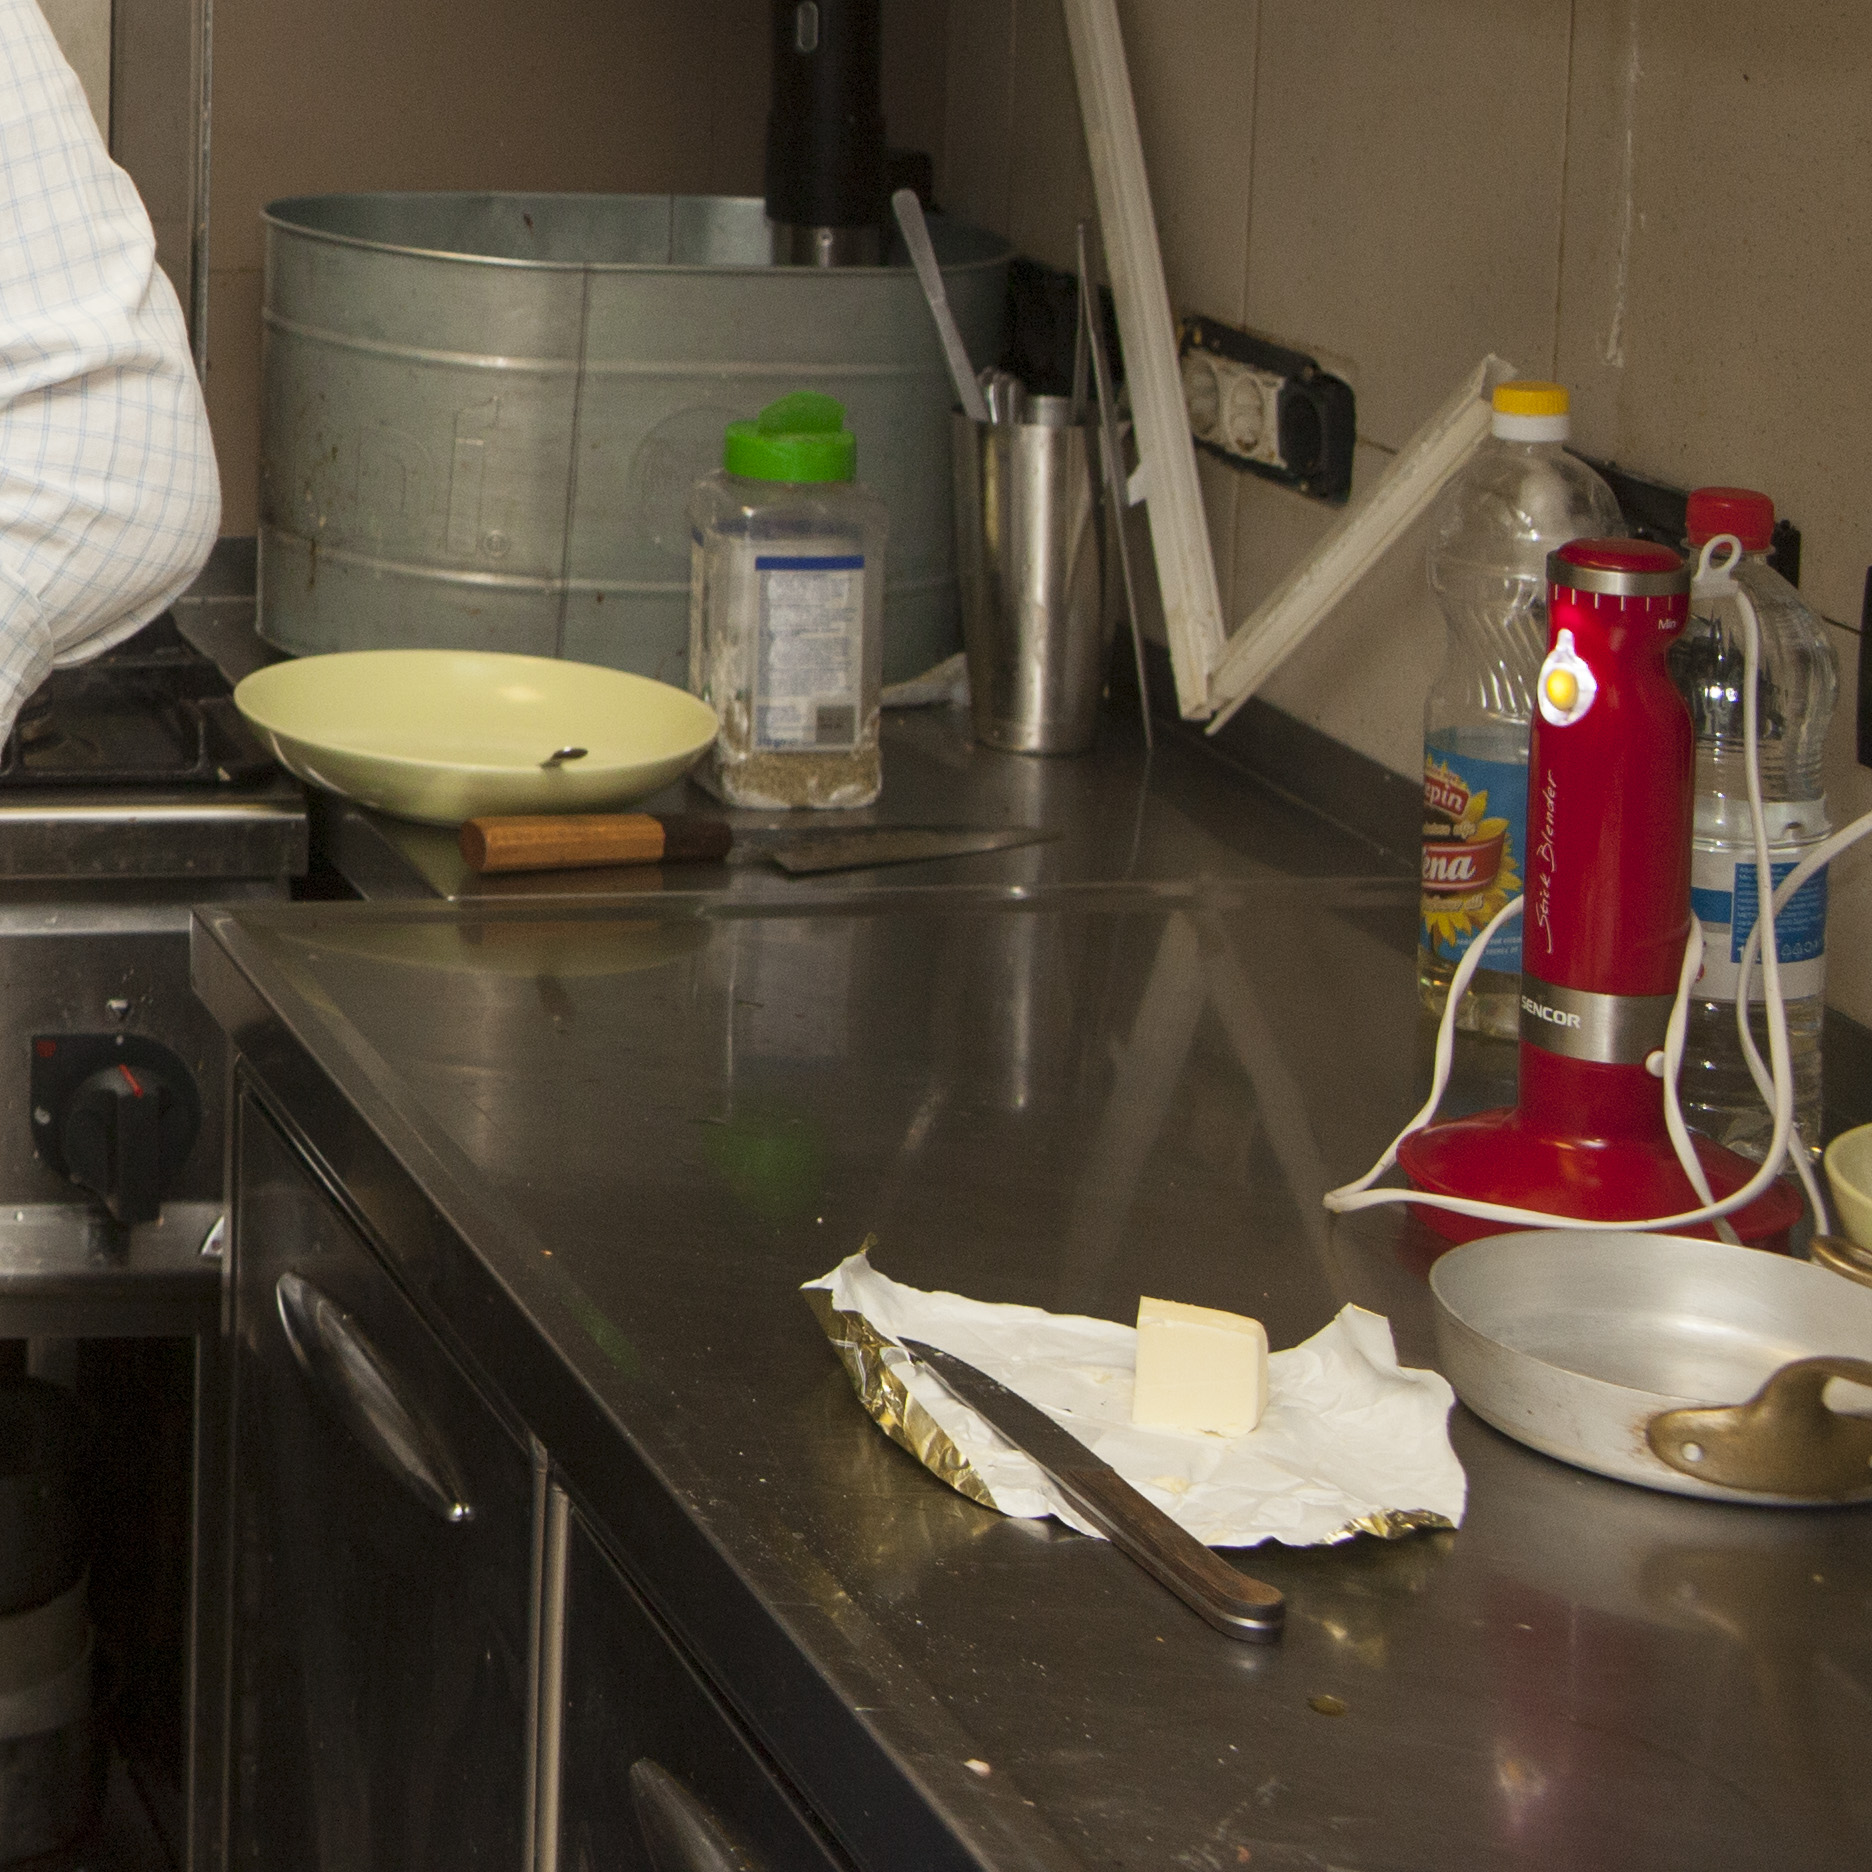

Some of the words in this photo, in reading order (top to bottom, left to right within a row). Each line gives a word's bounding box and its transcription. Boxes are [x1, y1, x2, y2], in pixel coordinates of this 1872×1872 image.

[1425, 783, 1464, 812] epin
[1536, 769, 1557, 873] Blender
[1535, 873, 1553, 955] Stick
[1521, 994, 1581, 1029] SENCOR
